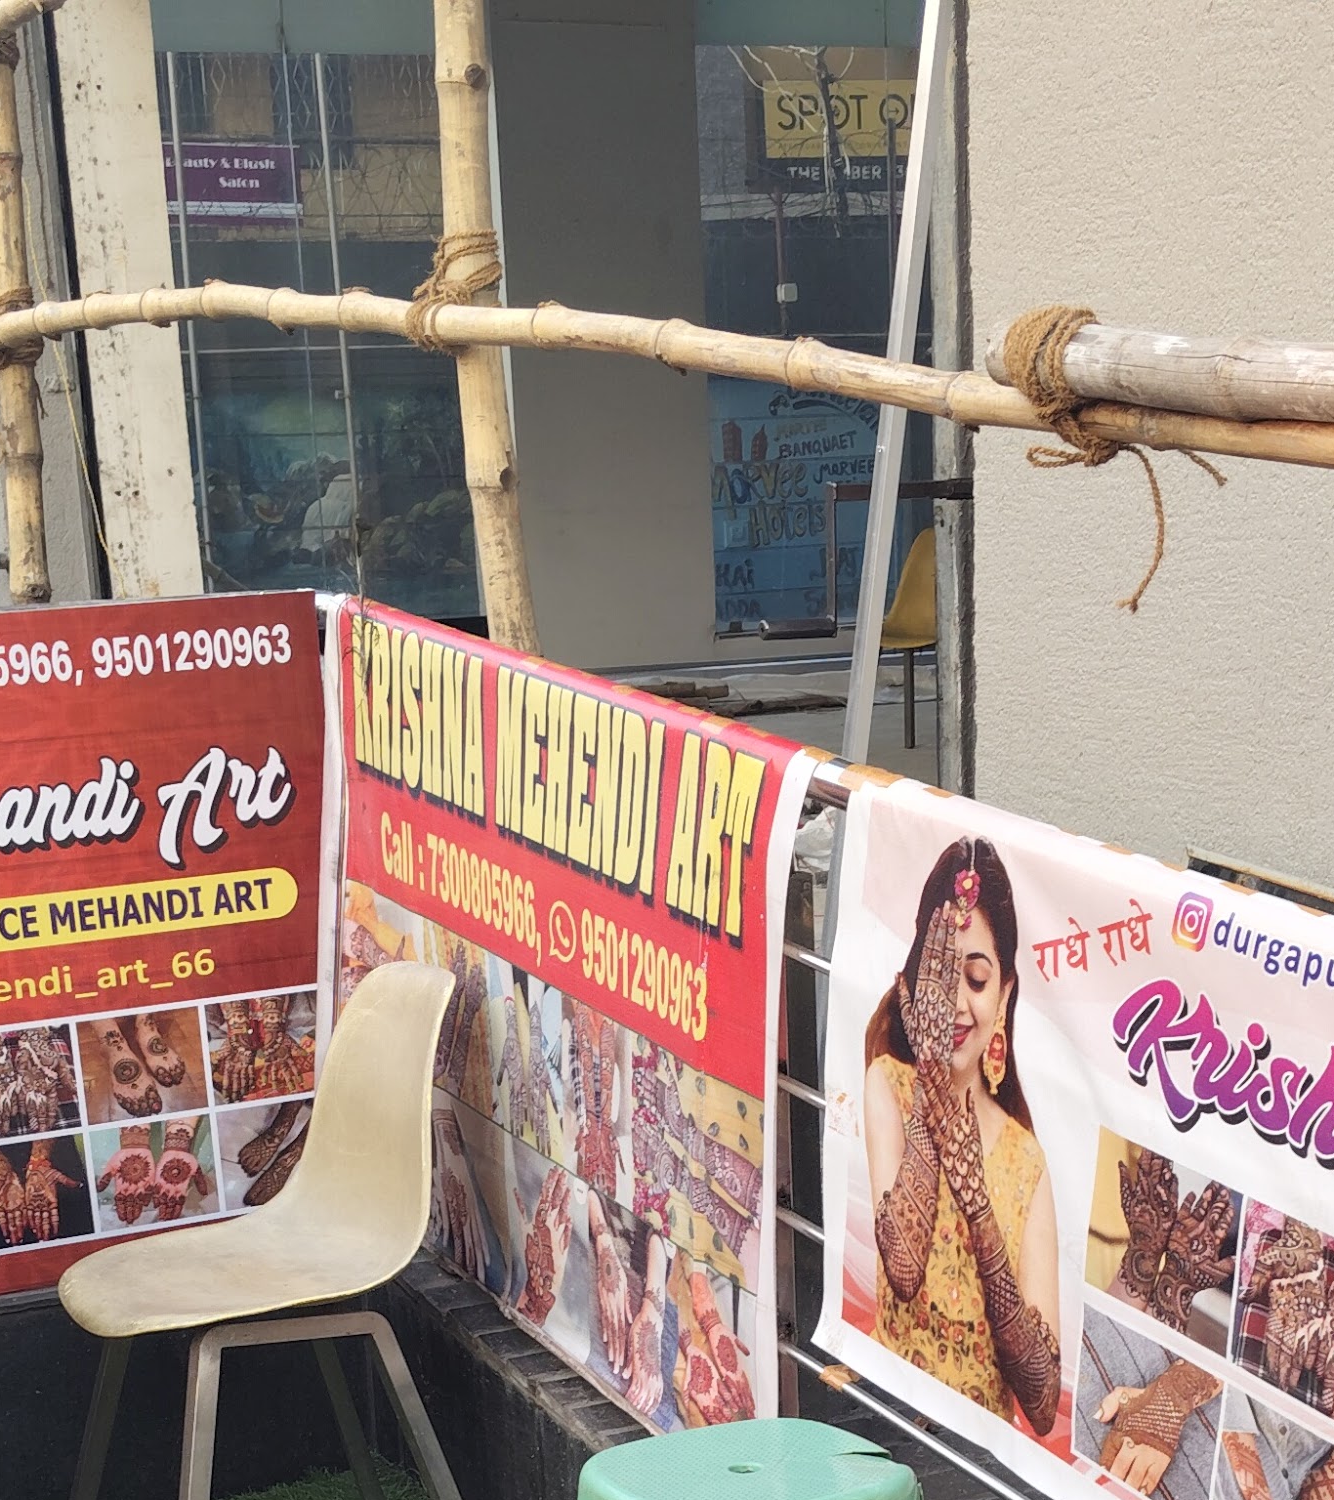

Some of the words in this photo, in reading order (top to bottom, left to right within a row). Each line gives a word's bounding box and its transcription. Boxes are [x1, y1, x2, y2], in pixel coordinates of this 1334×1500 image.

[218, 176, 260, 188] Salon
[233, 157, 276, 170] Blush
[92, 623, 292, 679] 9501290963
[157, 746, 295, 868] Art
[352, 614, 486, 822] KRISHNA
[495, 664, 667, 903] MEHENDI
[666, 730, 766, 944] ART
[49, 886, 204, 935] MEHANDI
[214, 878, 273, 915] ART
[381, 812, 412, 886] Call
[426, 833, 542, 967] 7300805966,
[581, 908, 708, 1042] 9501290963
[1032, 917, 1090, 983] राधे
[1098, 898, 1153, 966] राधे
